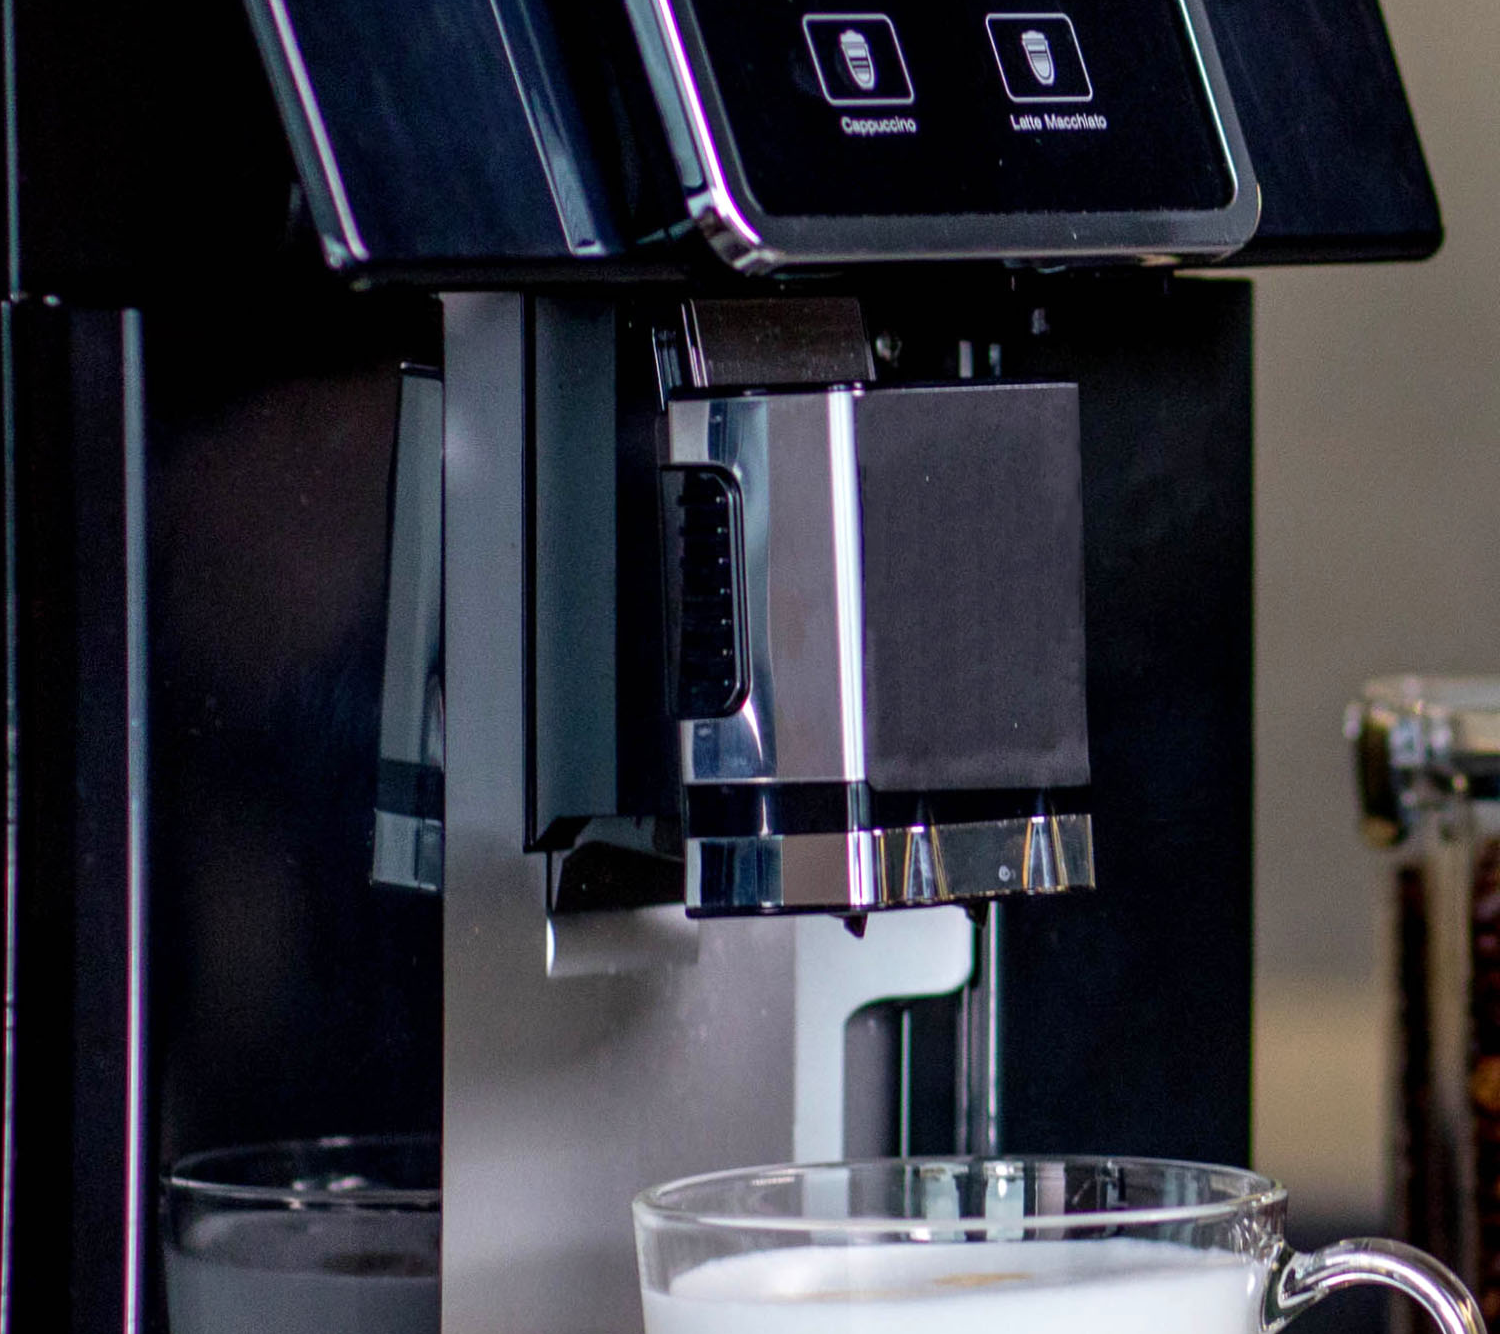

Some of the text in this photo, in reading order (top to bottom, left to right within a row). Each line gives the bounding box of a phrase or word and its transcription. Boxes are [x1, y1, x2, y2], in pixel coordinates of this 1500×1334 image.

[842, 115, 916, 135] Cappuccino
[1010, 113, 1107, 131] Latte Macchiato
